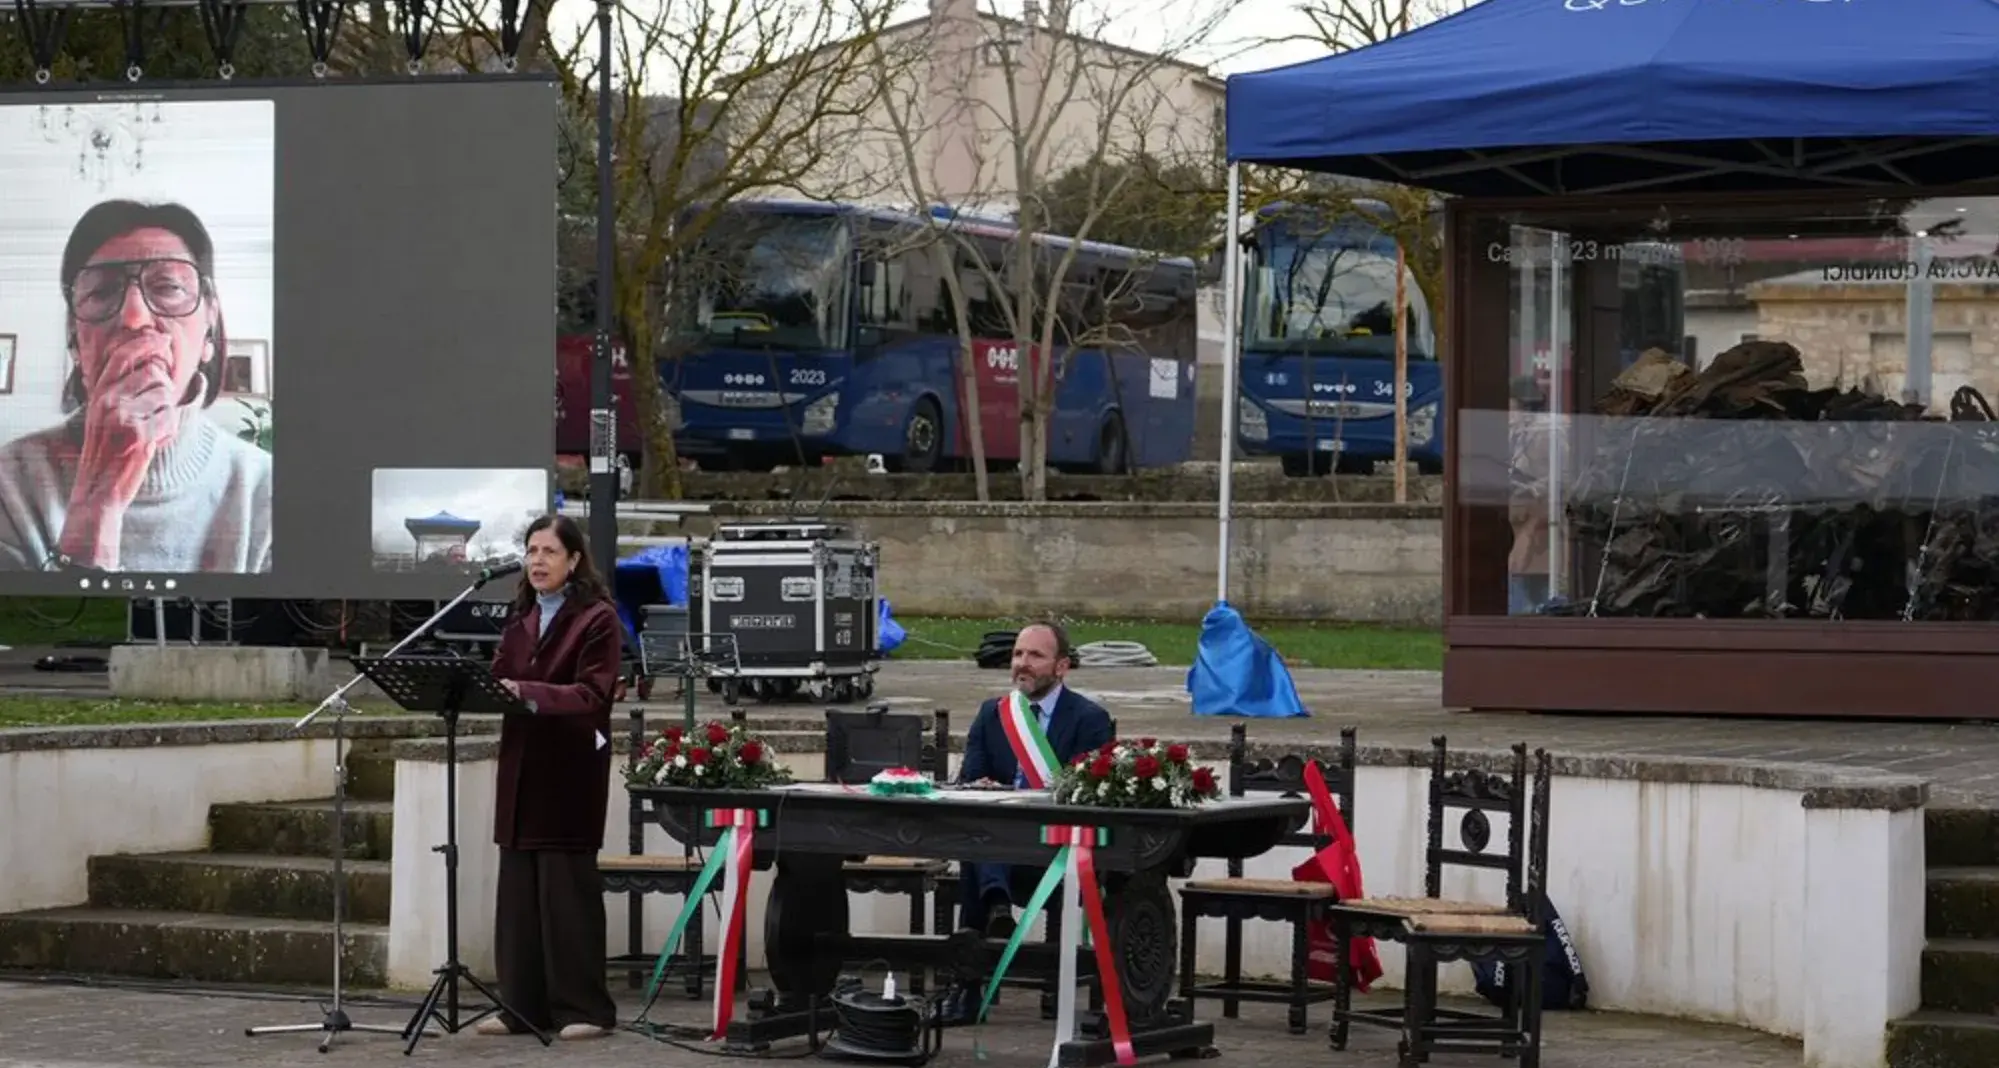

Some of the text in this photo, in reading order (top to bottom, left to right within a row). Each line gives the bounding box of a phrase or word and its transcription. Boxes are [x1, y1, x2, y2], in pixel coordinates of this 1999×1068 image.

[1572, 241, 1598, 260] 23
[790, 369, 826, 385] 2023
[1373, 380, 1413, 397] 349
